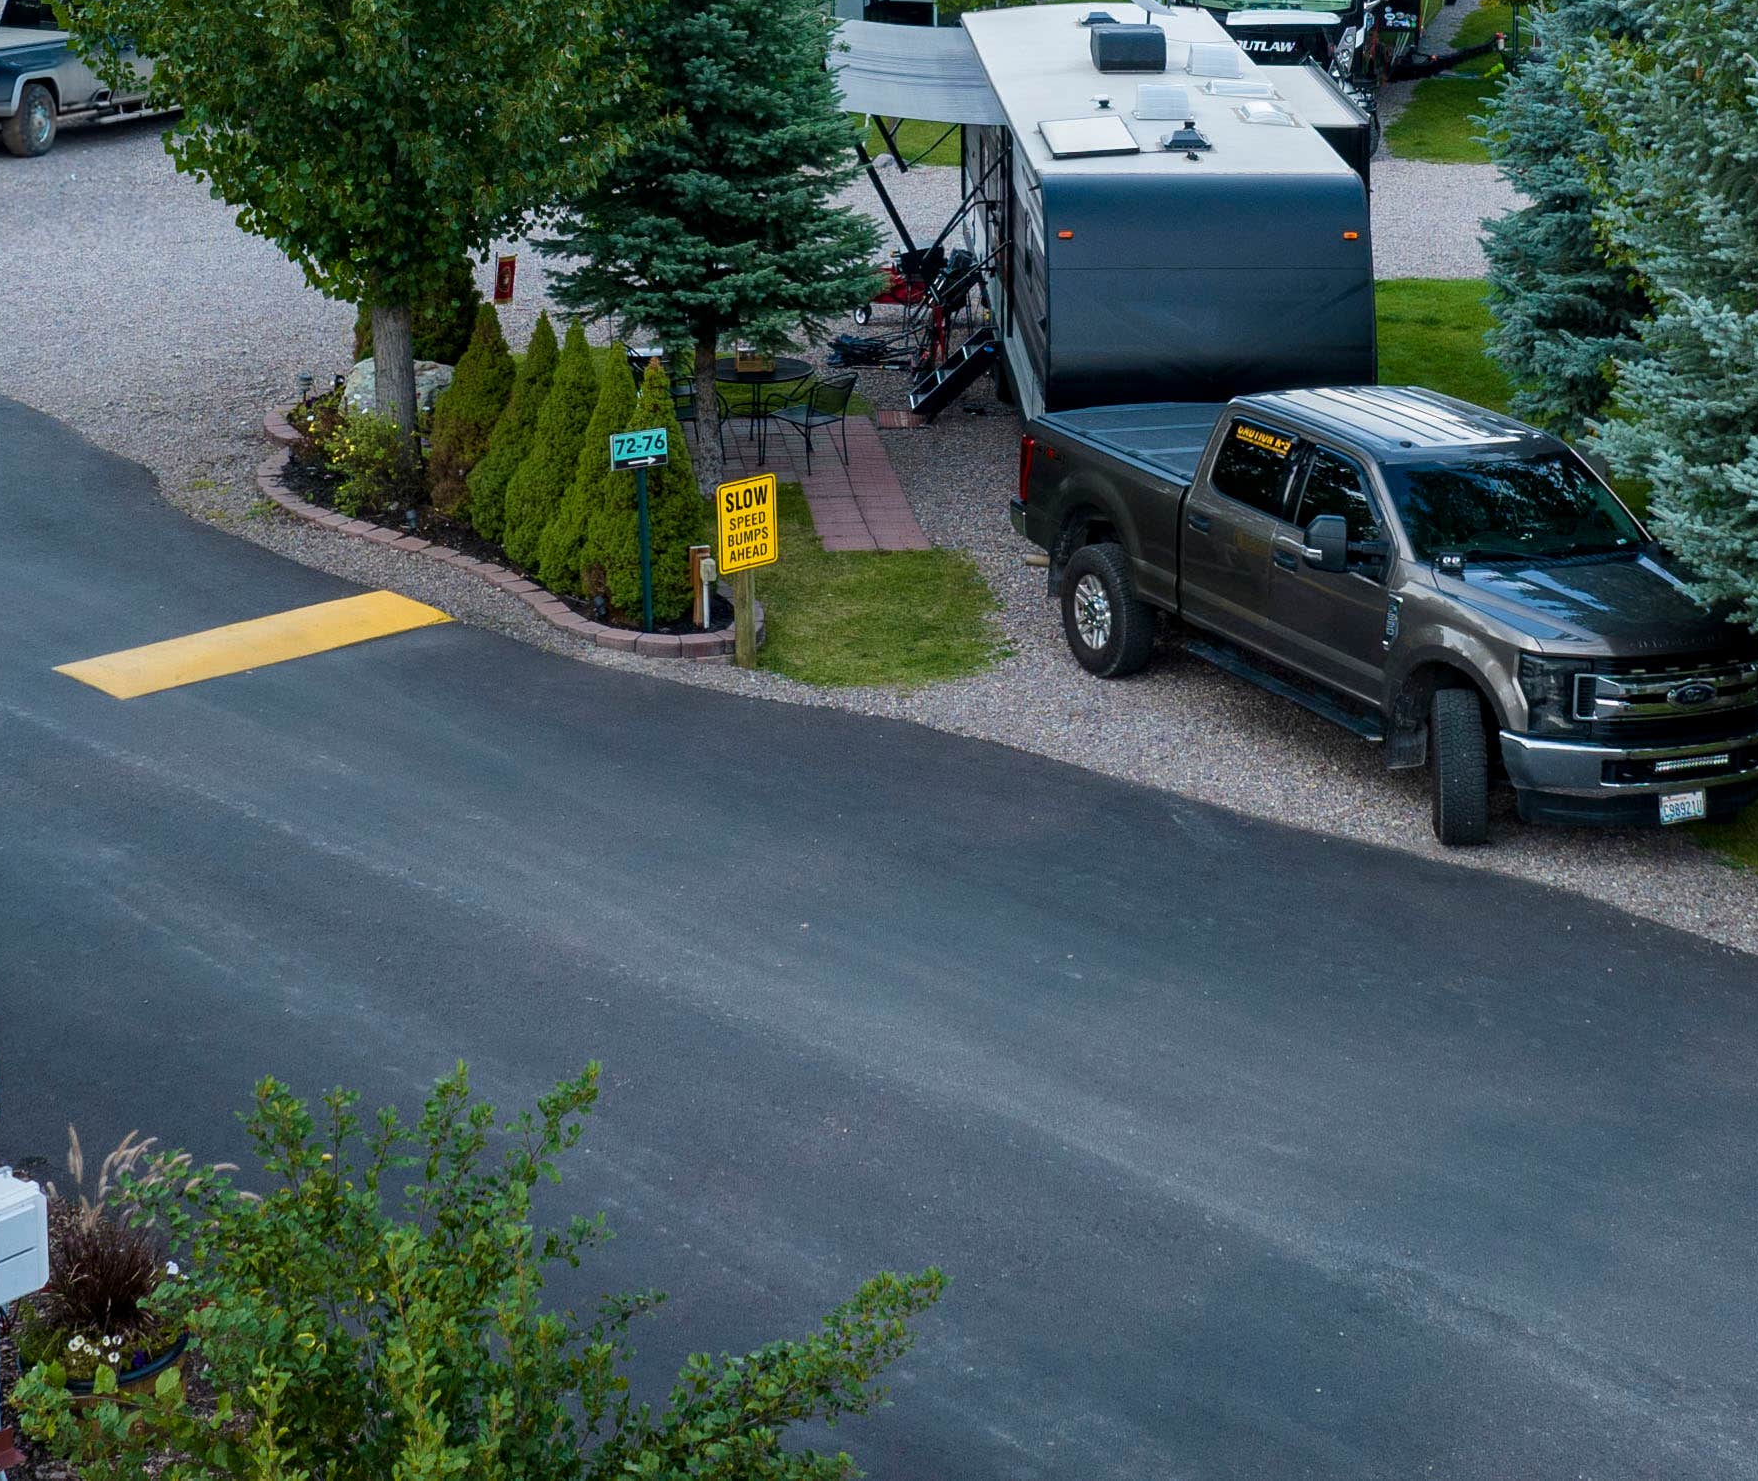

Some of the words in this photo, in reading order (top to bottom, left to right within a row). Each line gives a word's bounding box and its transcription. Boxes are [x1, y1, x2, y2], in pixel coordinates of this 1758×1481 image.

[614, 436, 665, 456] 72-76
[725, 484, 768, 513] SLOW
[729, 510, 766, 531] SPEED
[727, 526, 769, 548] BUMPS
[729, 542, 768, 564] AHEAD
